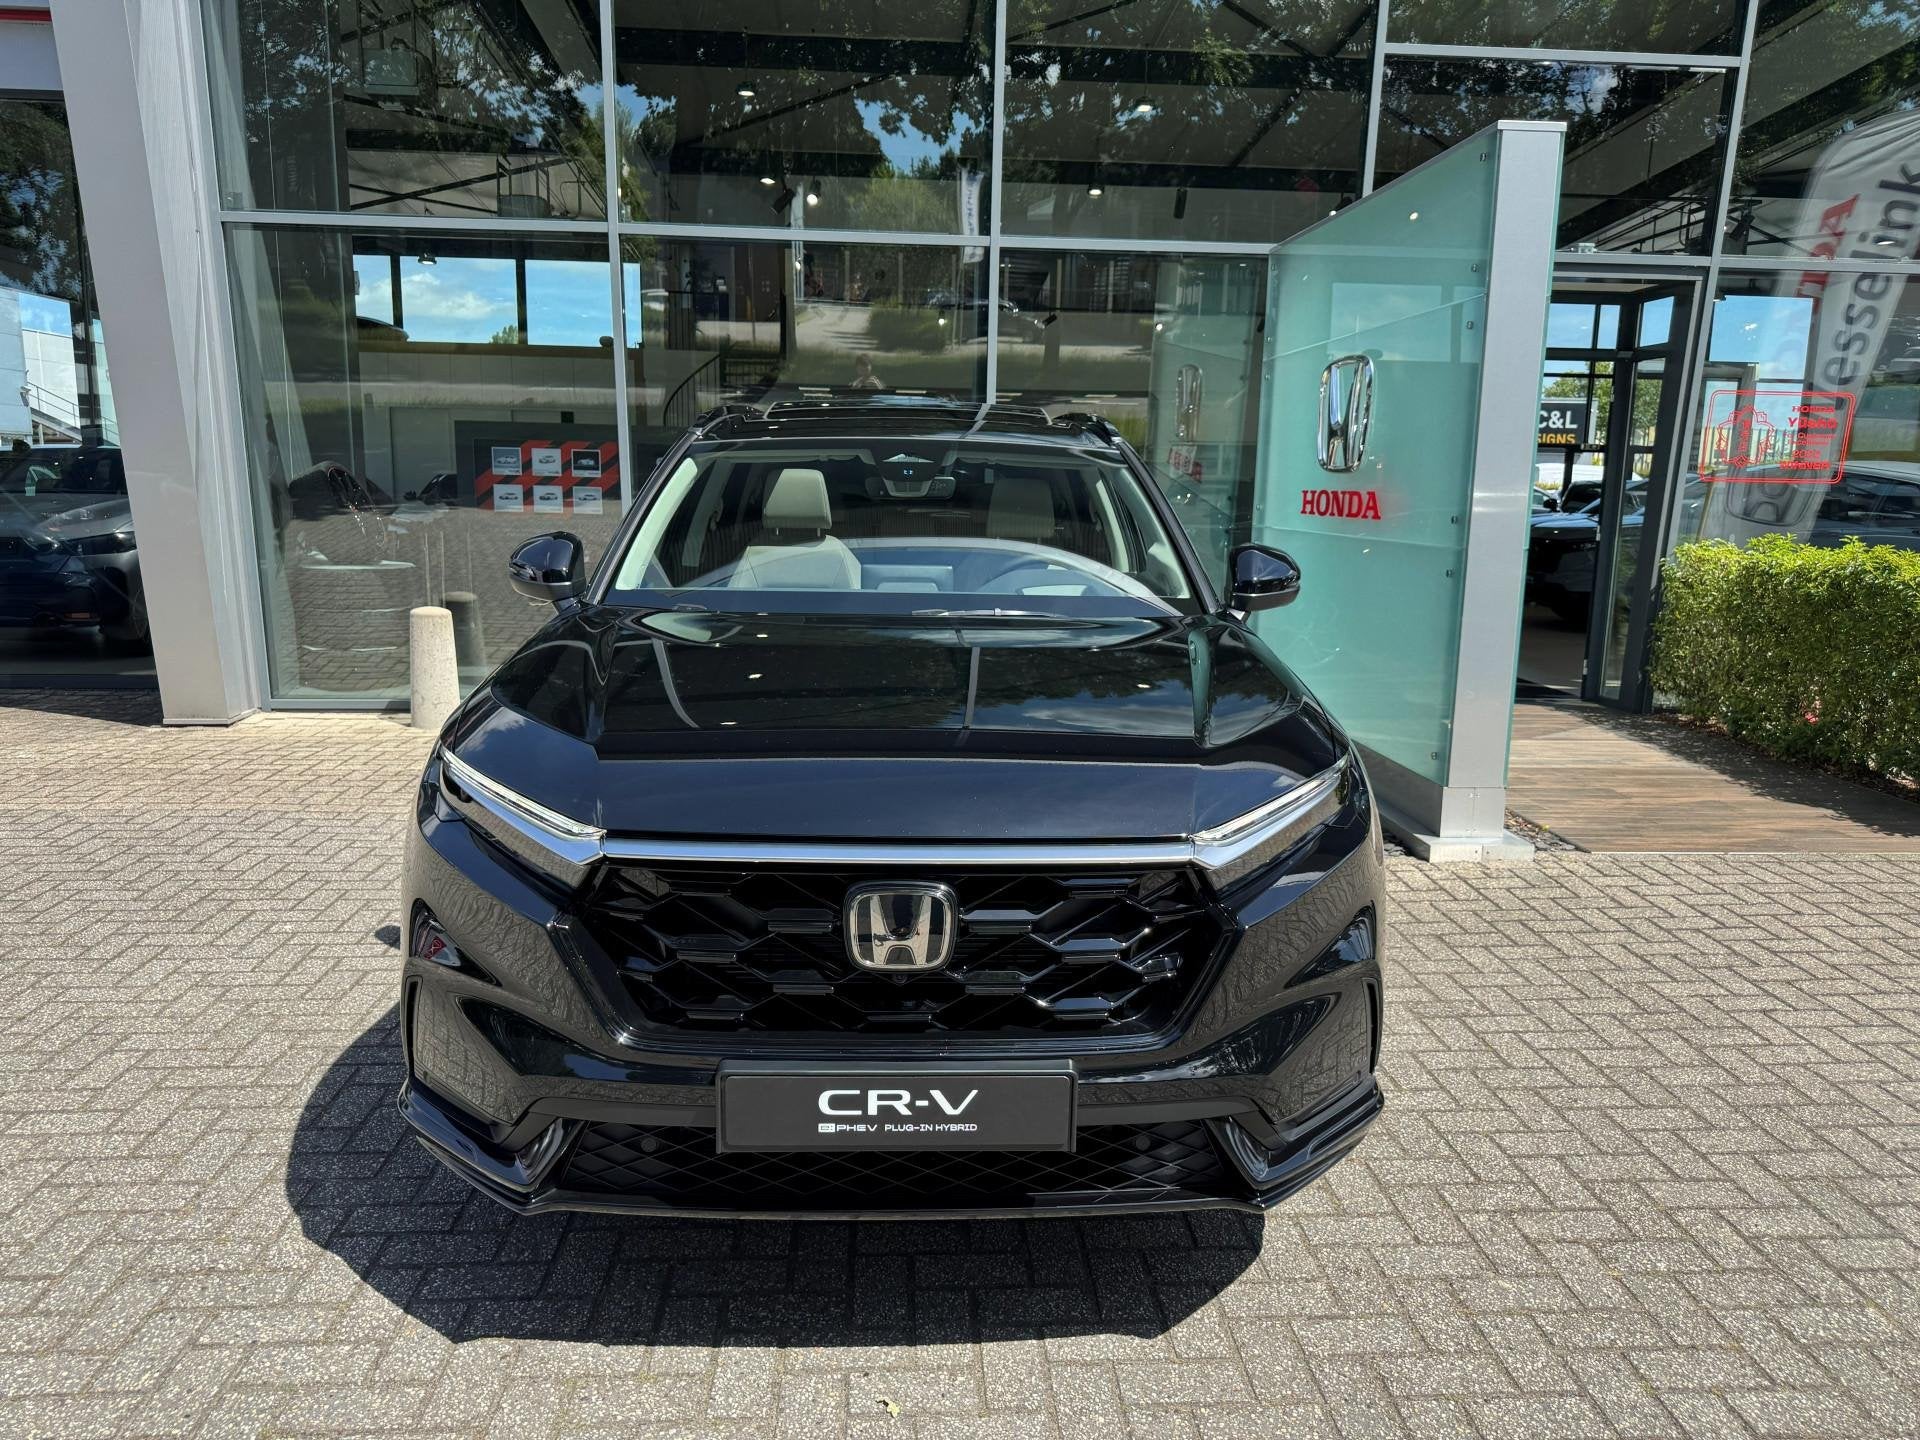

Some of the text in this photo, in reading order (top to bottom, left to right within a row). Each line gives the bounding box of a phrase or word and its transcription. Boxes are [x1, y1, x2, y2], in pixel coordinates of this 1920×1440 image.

[1300, 490, 1381, 520] HONDA
[818, 1089, 978, 1115] CR-V
[884, 1123, 933, 1132] PLUG-IN
[935, 1123, 978, 1132] HYBRID
